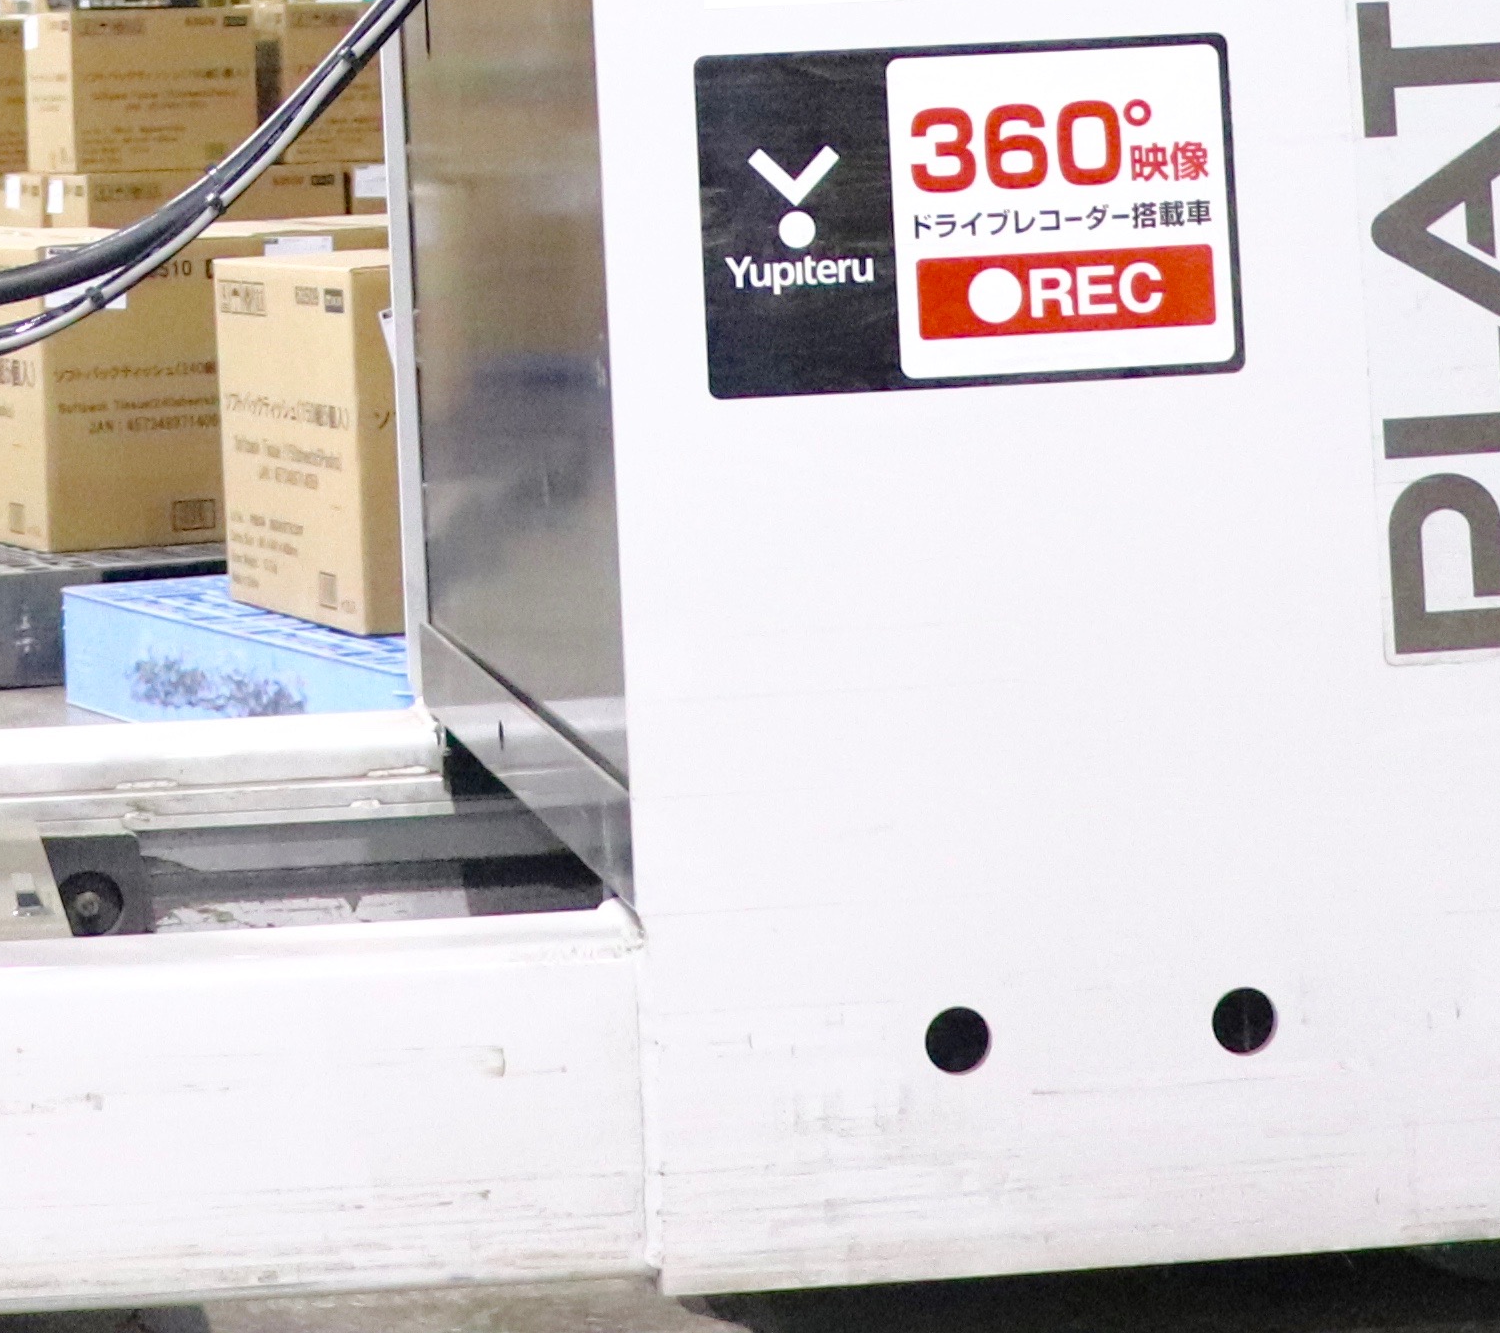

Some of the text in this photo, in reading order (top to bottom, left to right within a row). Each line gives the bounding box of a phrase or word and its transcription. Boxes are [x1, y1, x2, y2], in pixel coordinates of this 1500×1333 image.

[913, 199, 1212, 239] ドライブレコーダー搭載車
[725, 255, 875, 295] Yupiteru
